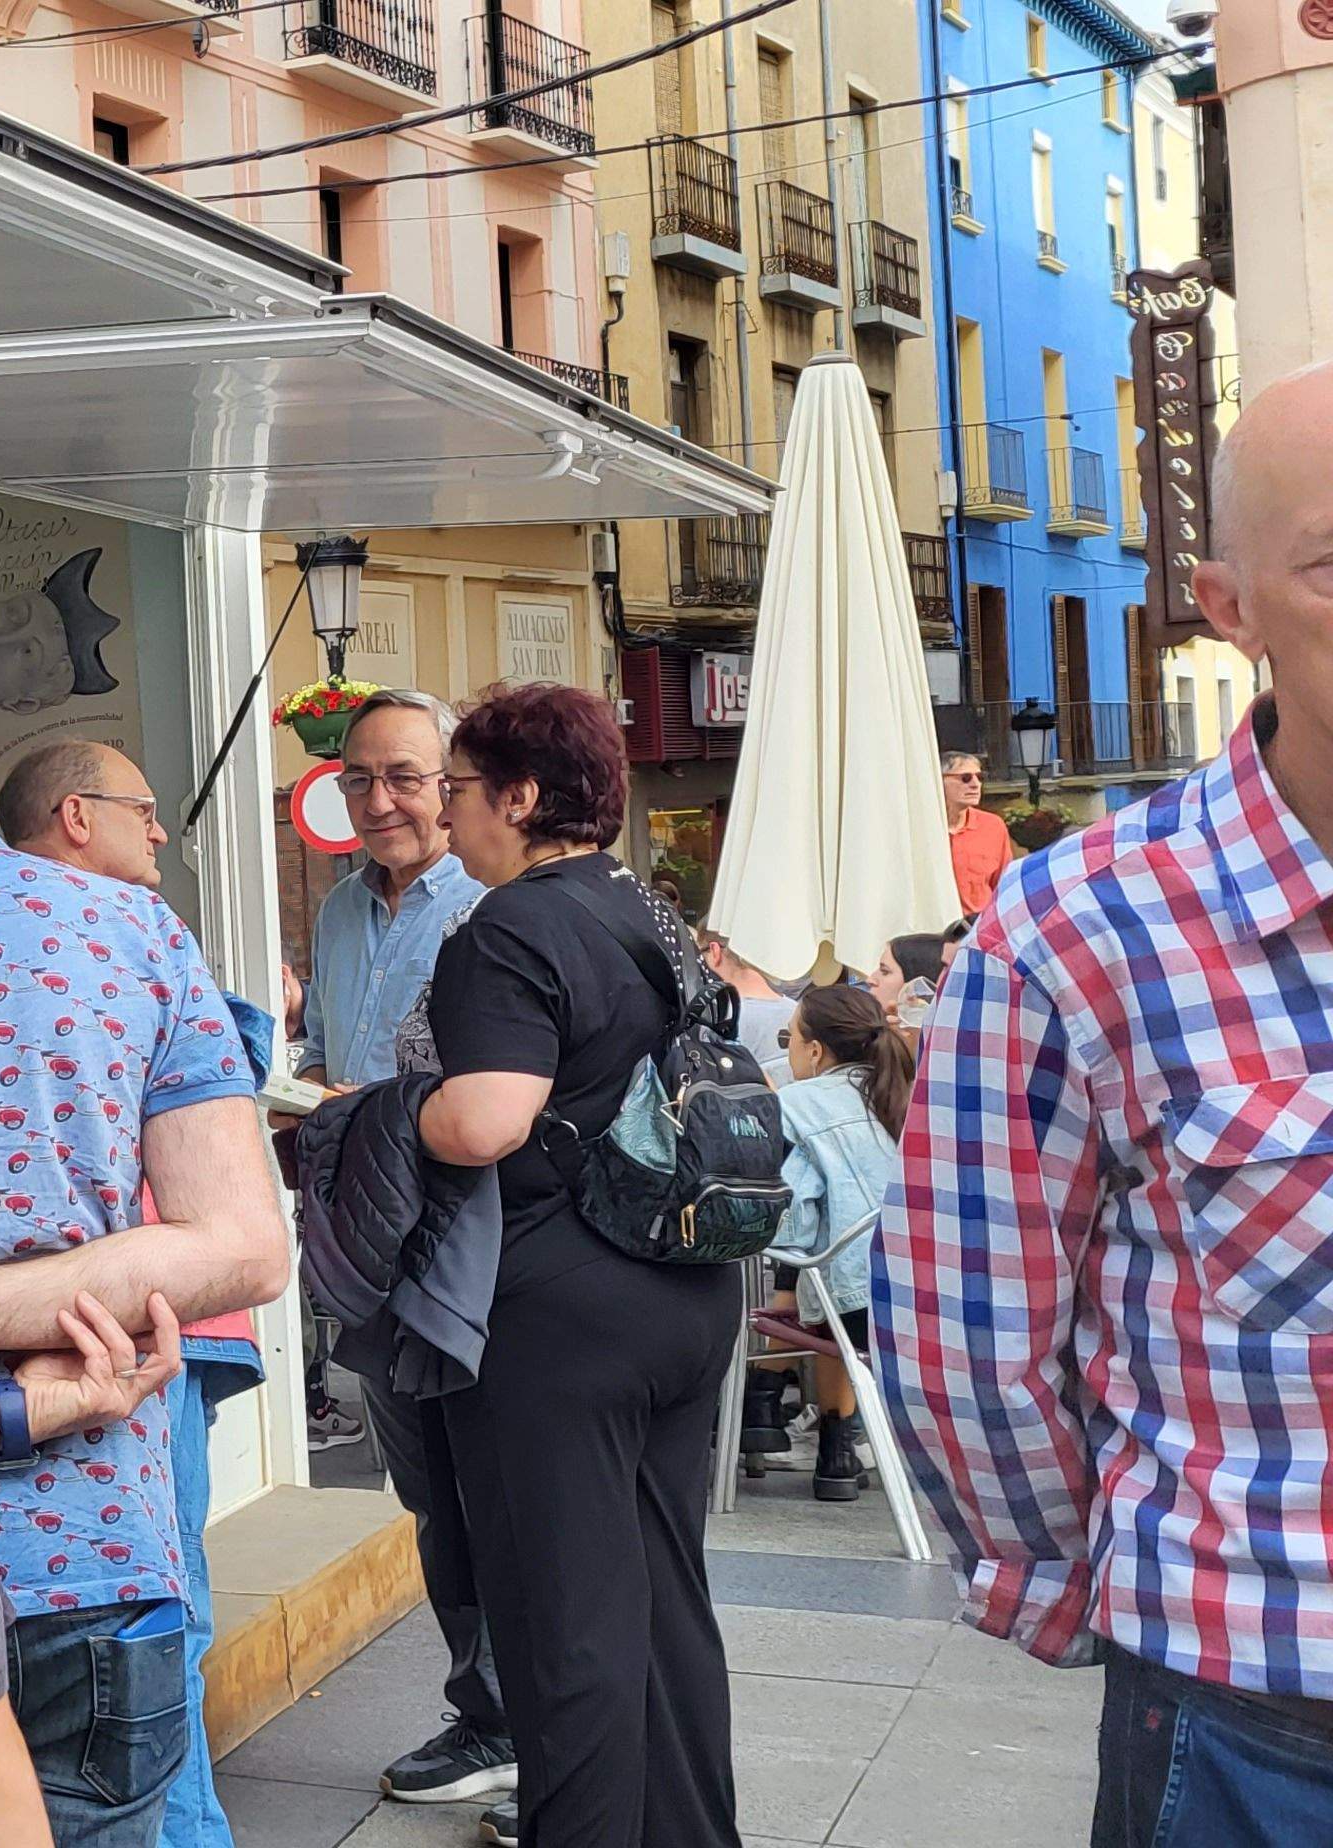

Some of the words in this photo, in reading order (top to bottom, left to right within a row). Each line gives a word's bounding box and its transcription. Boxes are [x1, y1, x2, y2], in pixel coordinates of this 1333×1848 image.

[348, 621, 399, 654] ONREAL
[507, 613, 566, 644] ALMACENES
[512, 647, 533, 676] SAN
[536, 648, 563, 676] JUAN
